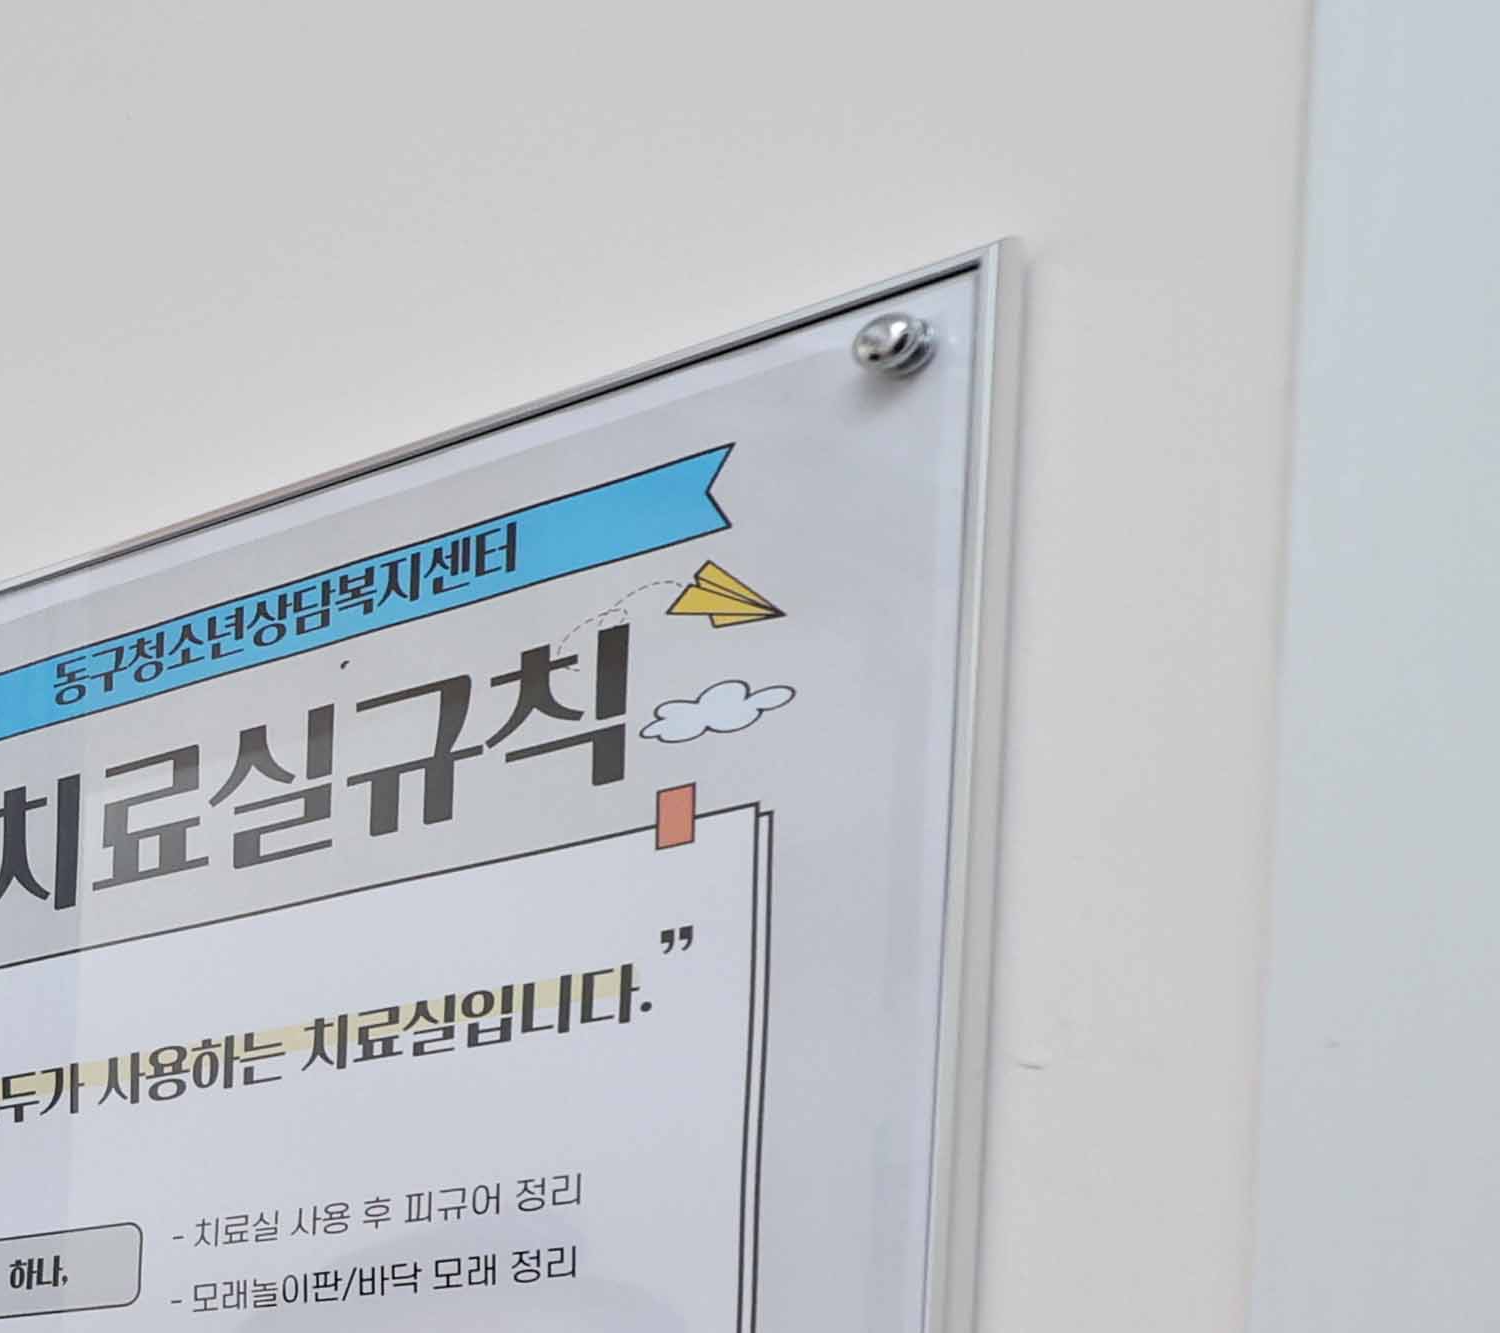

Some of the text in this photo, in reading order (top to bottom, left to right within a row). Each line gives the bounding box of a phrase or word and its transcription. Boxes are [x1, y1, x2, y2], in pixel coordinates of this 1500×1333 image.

[52, 520, 518, 707] 동구청소년상담복지센터
[96, 1030, 287, 1106] 사용하는
[193, 1171, 583, 1248] 치료실 사용 후 피규어 정리
[8, 1254, 69, 1291] 하나,
[192, 1244, 578, 1314] 모래놀이판/바닥 모래 정리
